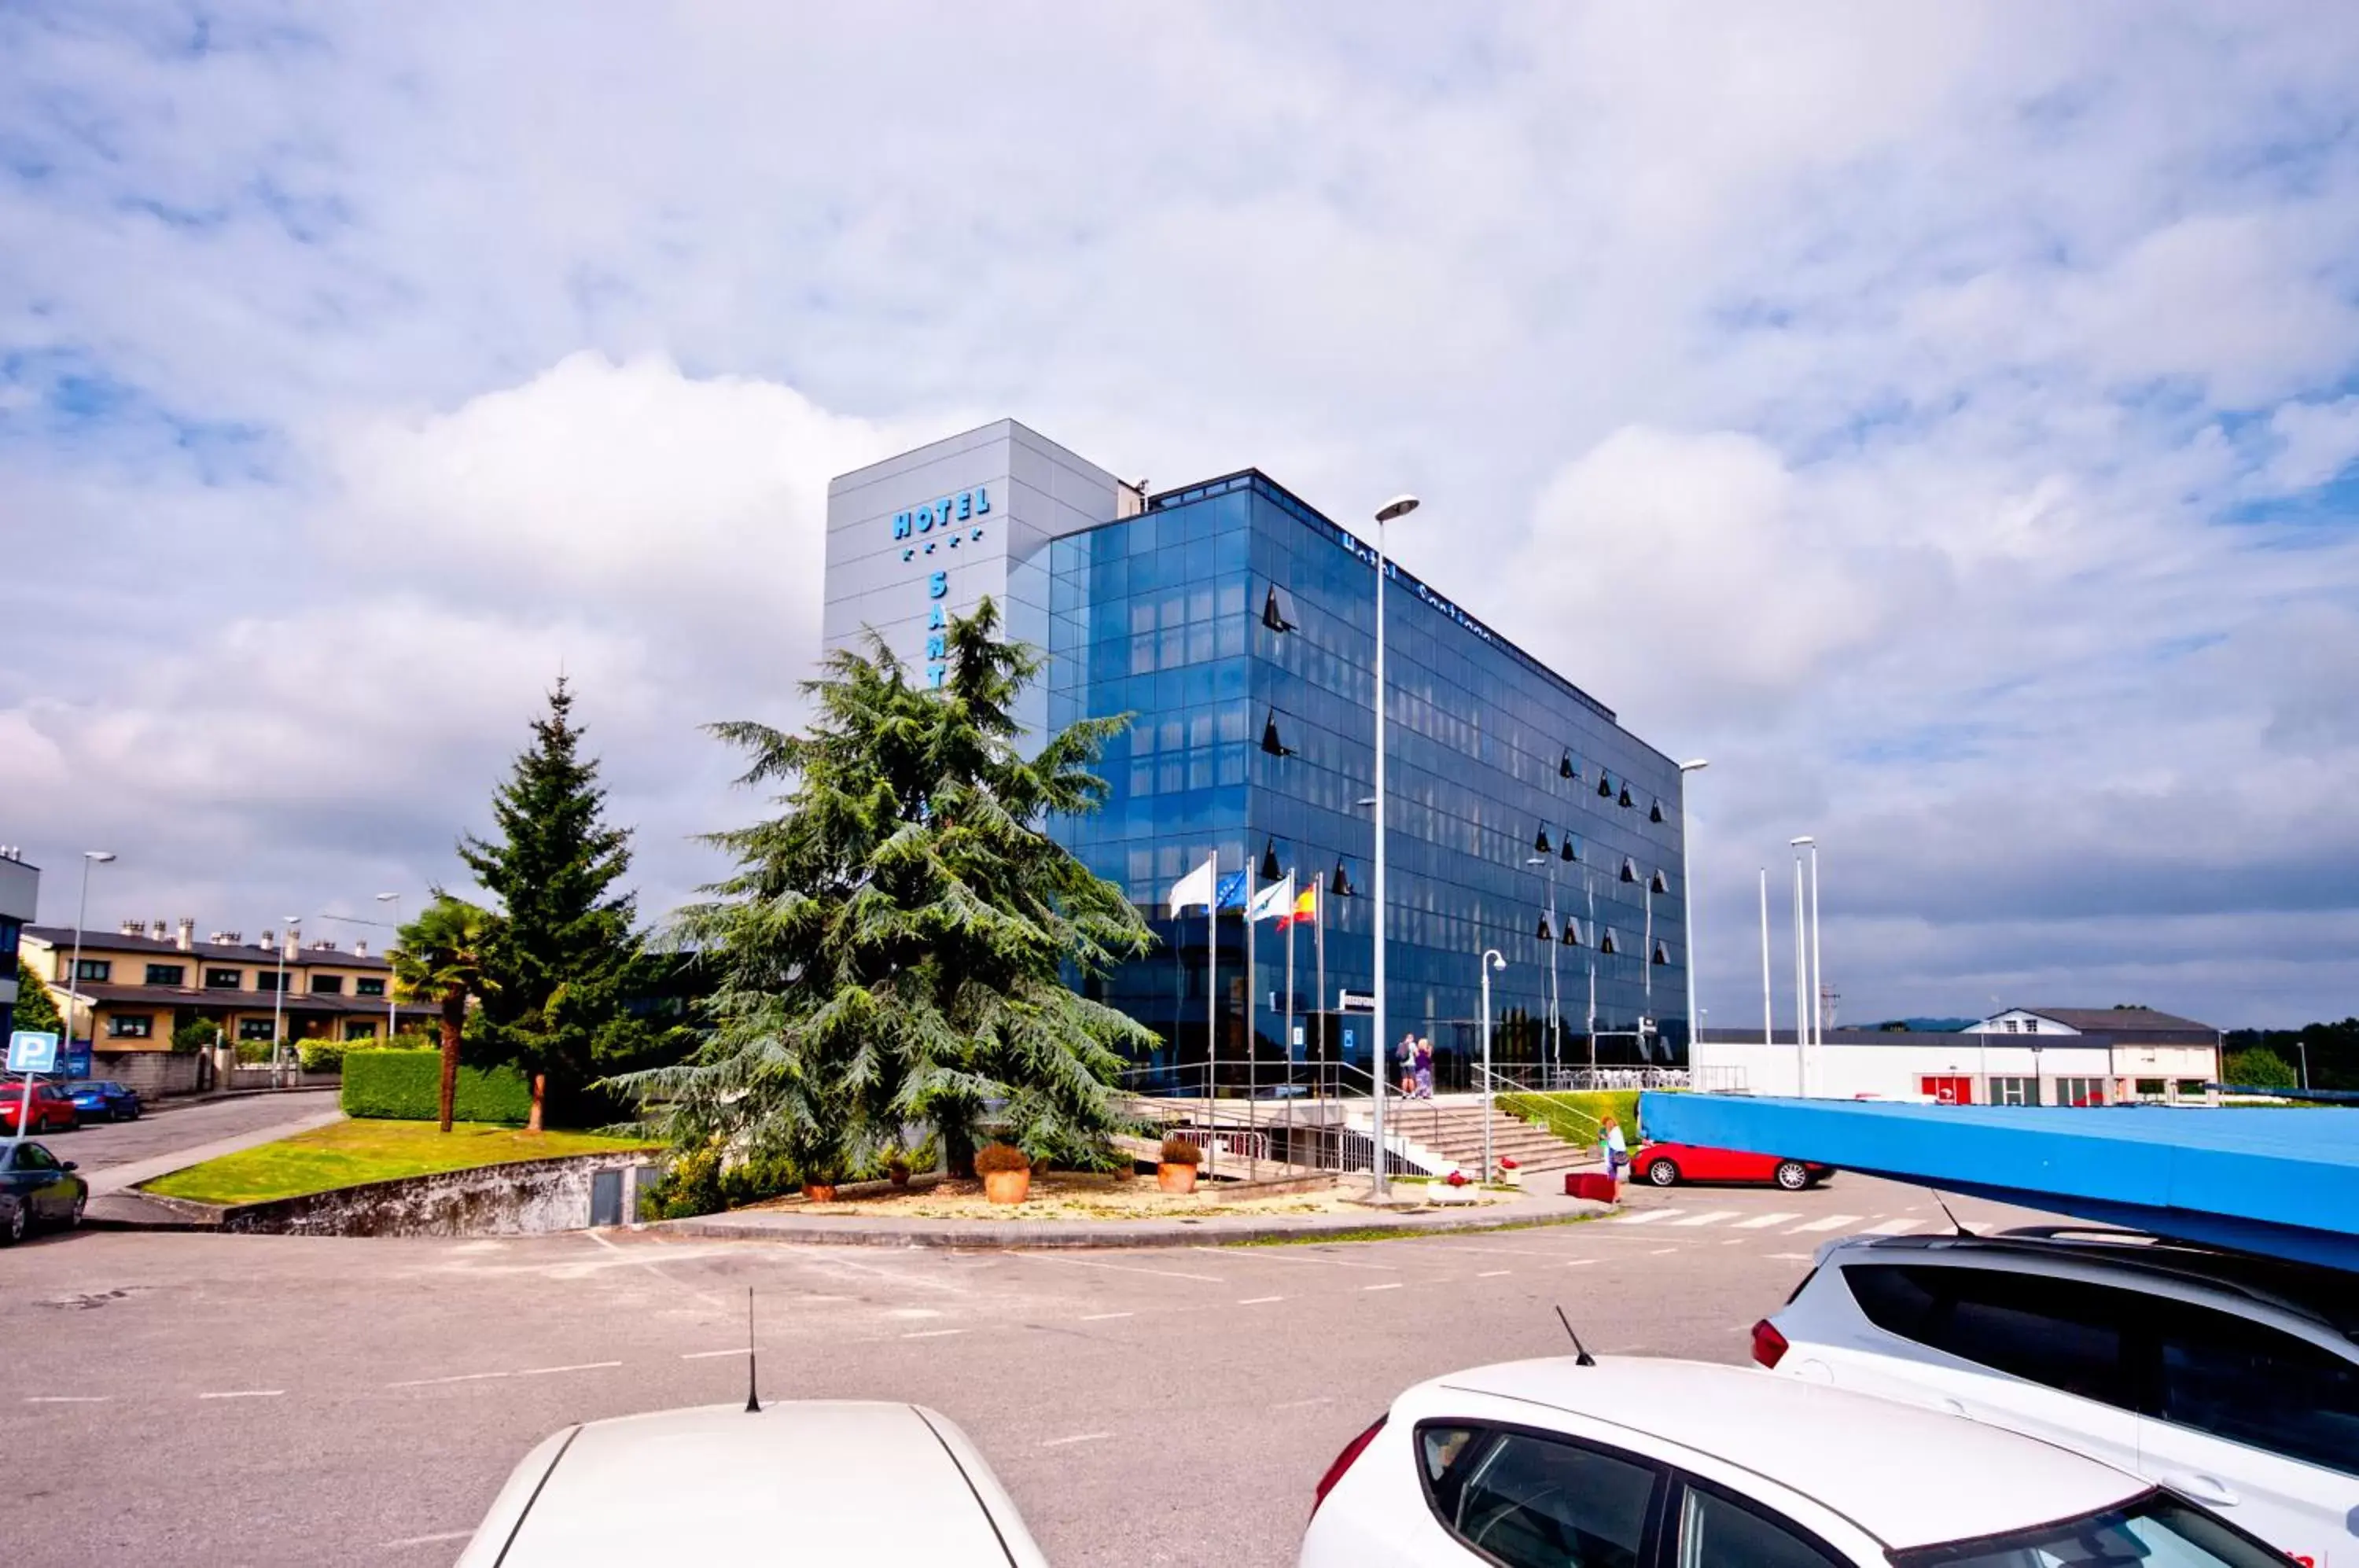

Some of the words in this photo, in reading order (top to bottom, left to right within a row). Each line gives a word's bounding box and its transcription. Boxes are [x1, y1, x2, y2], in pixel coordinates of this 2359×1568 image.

[893, 486, 990, 540] HOTEL
[926, 570, 948, 690] SANT
[16, 1036, 46, 1067] P
